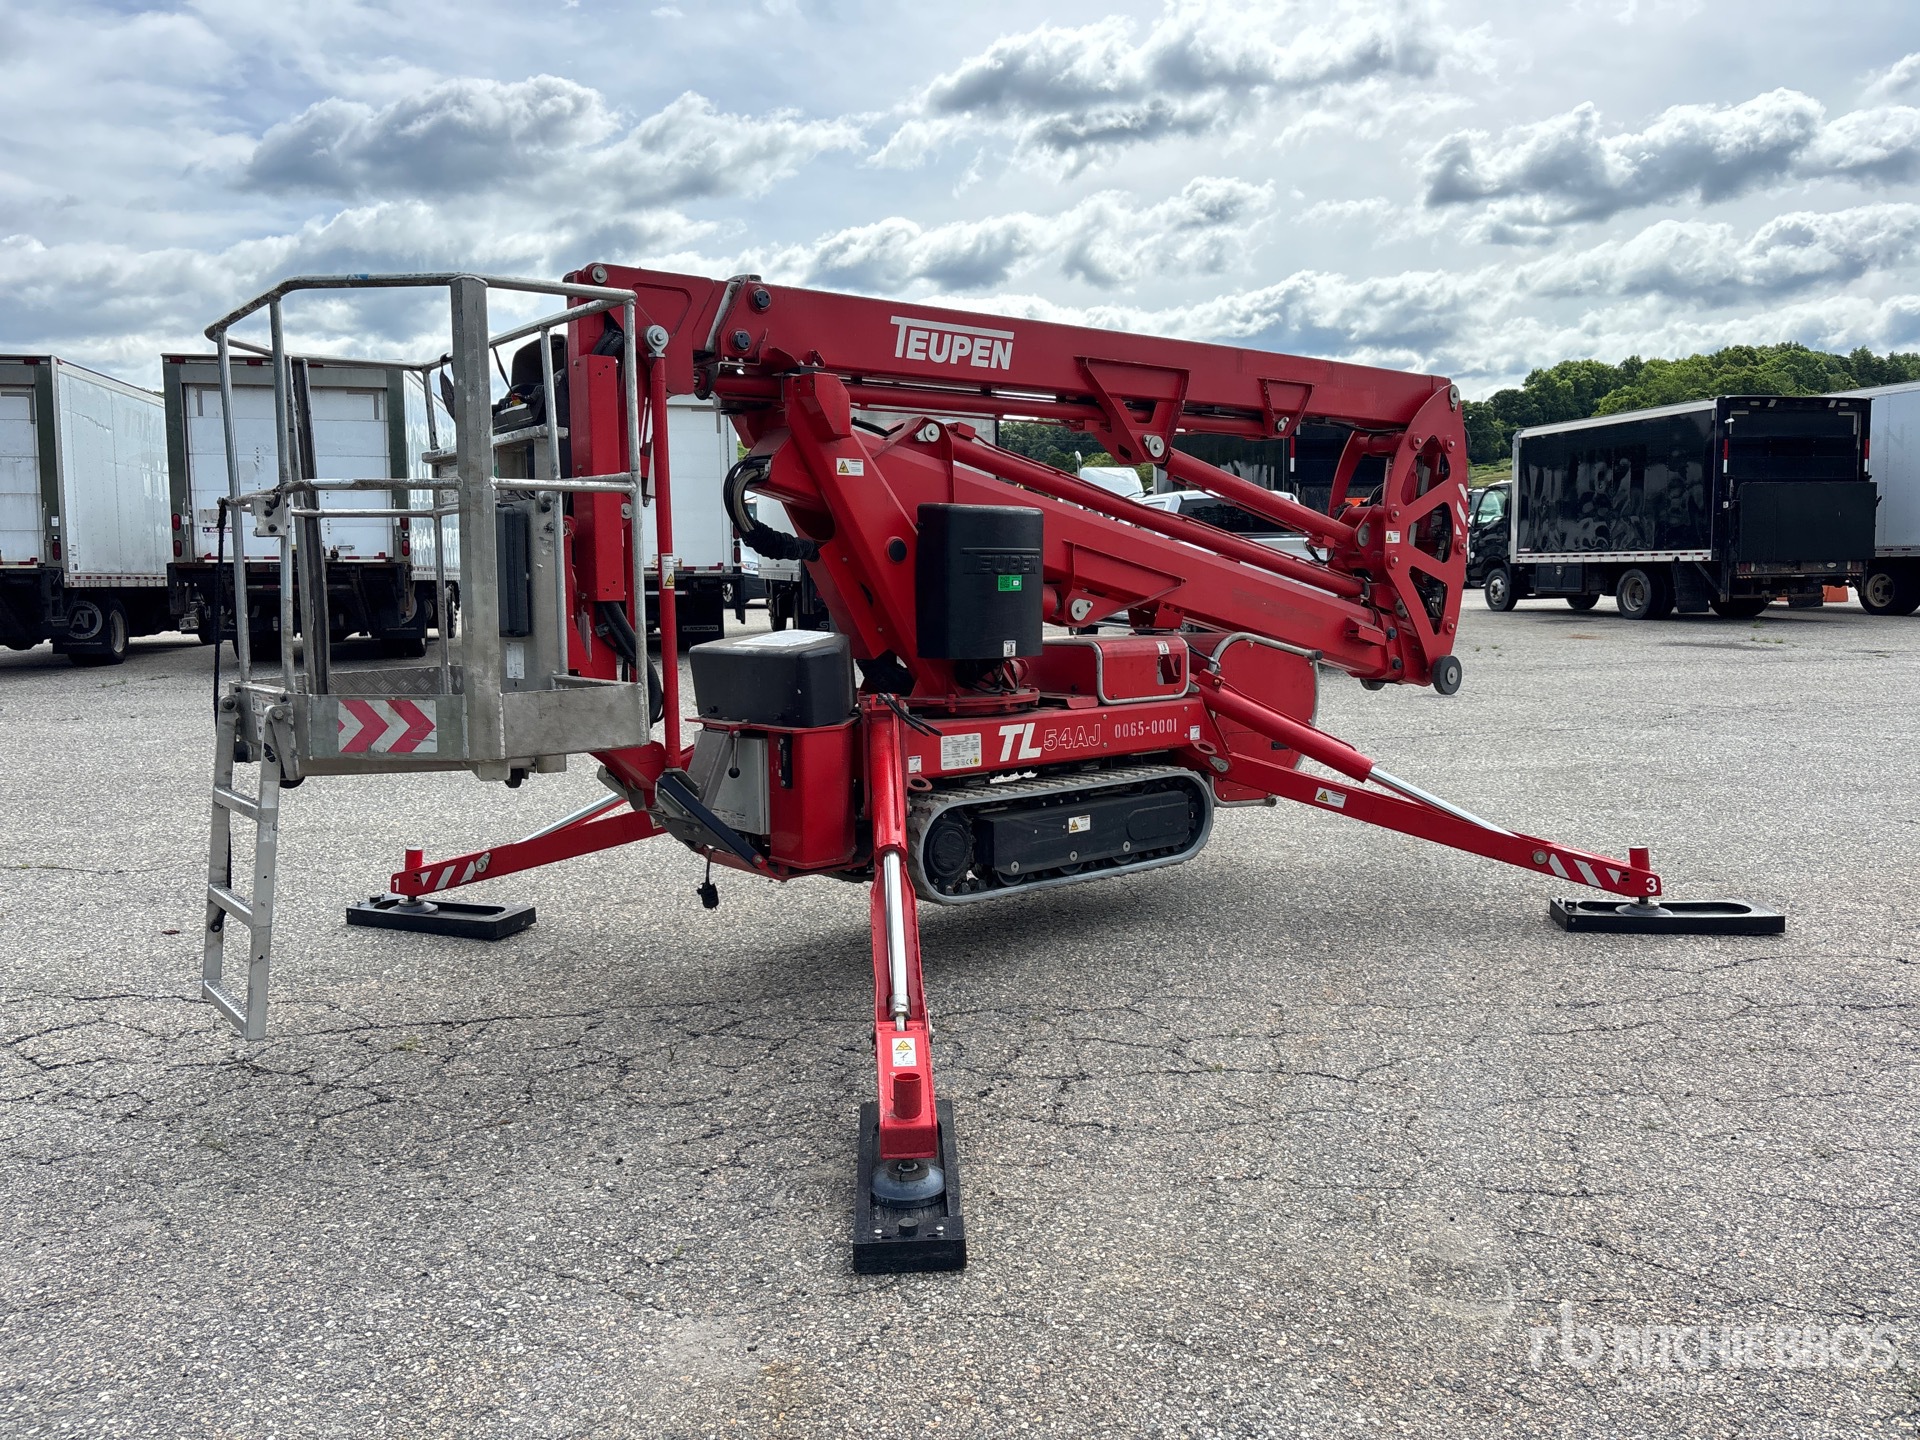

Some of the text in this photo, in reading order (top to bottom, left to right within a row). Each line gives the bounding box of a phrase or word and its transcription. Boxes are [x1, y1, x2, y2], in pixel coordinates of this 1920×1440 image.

[889, 315, 1015, 370] TEUPEN
[998, 722, 1042, 762] TL
[1043, 723, 1100, 751] 54AJ
[393, 878, 400, 892] 1
[1645, 877, 1658, 893] 3
